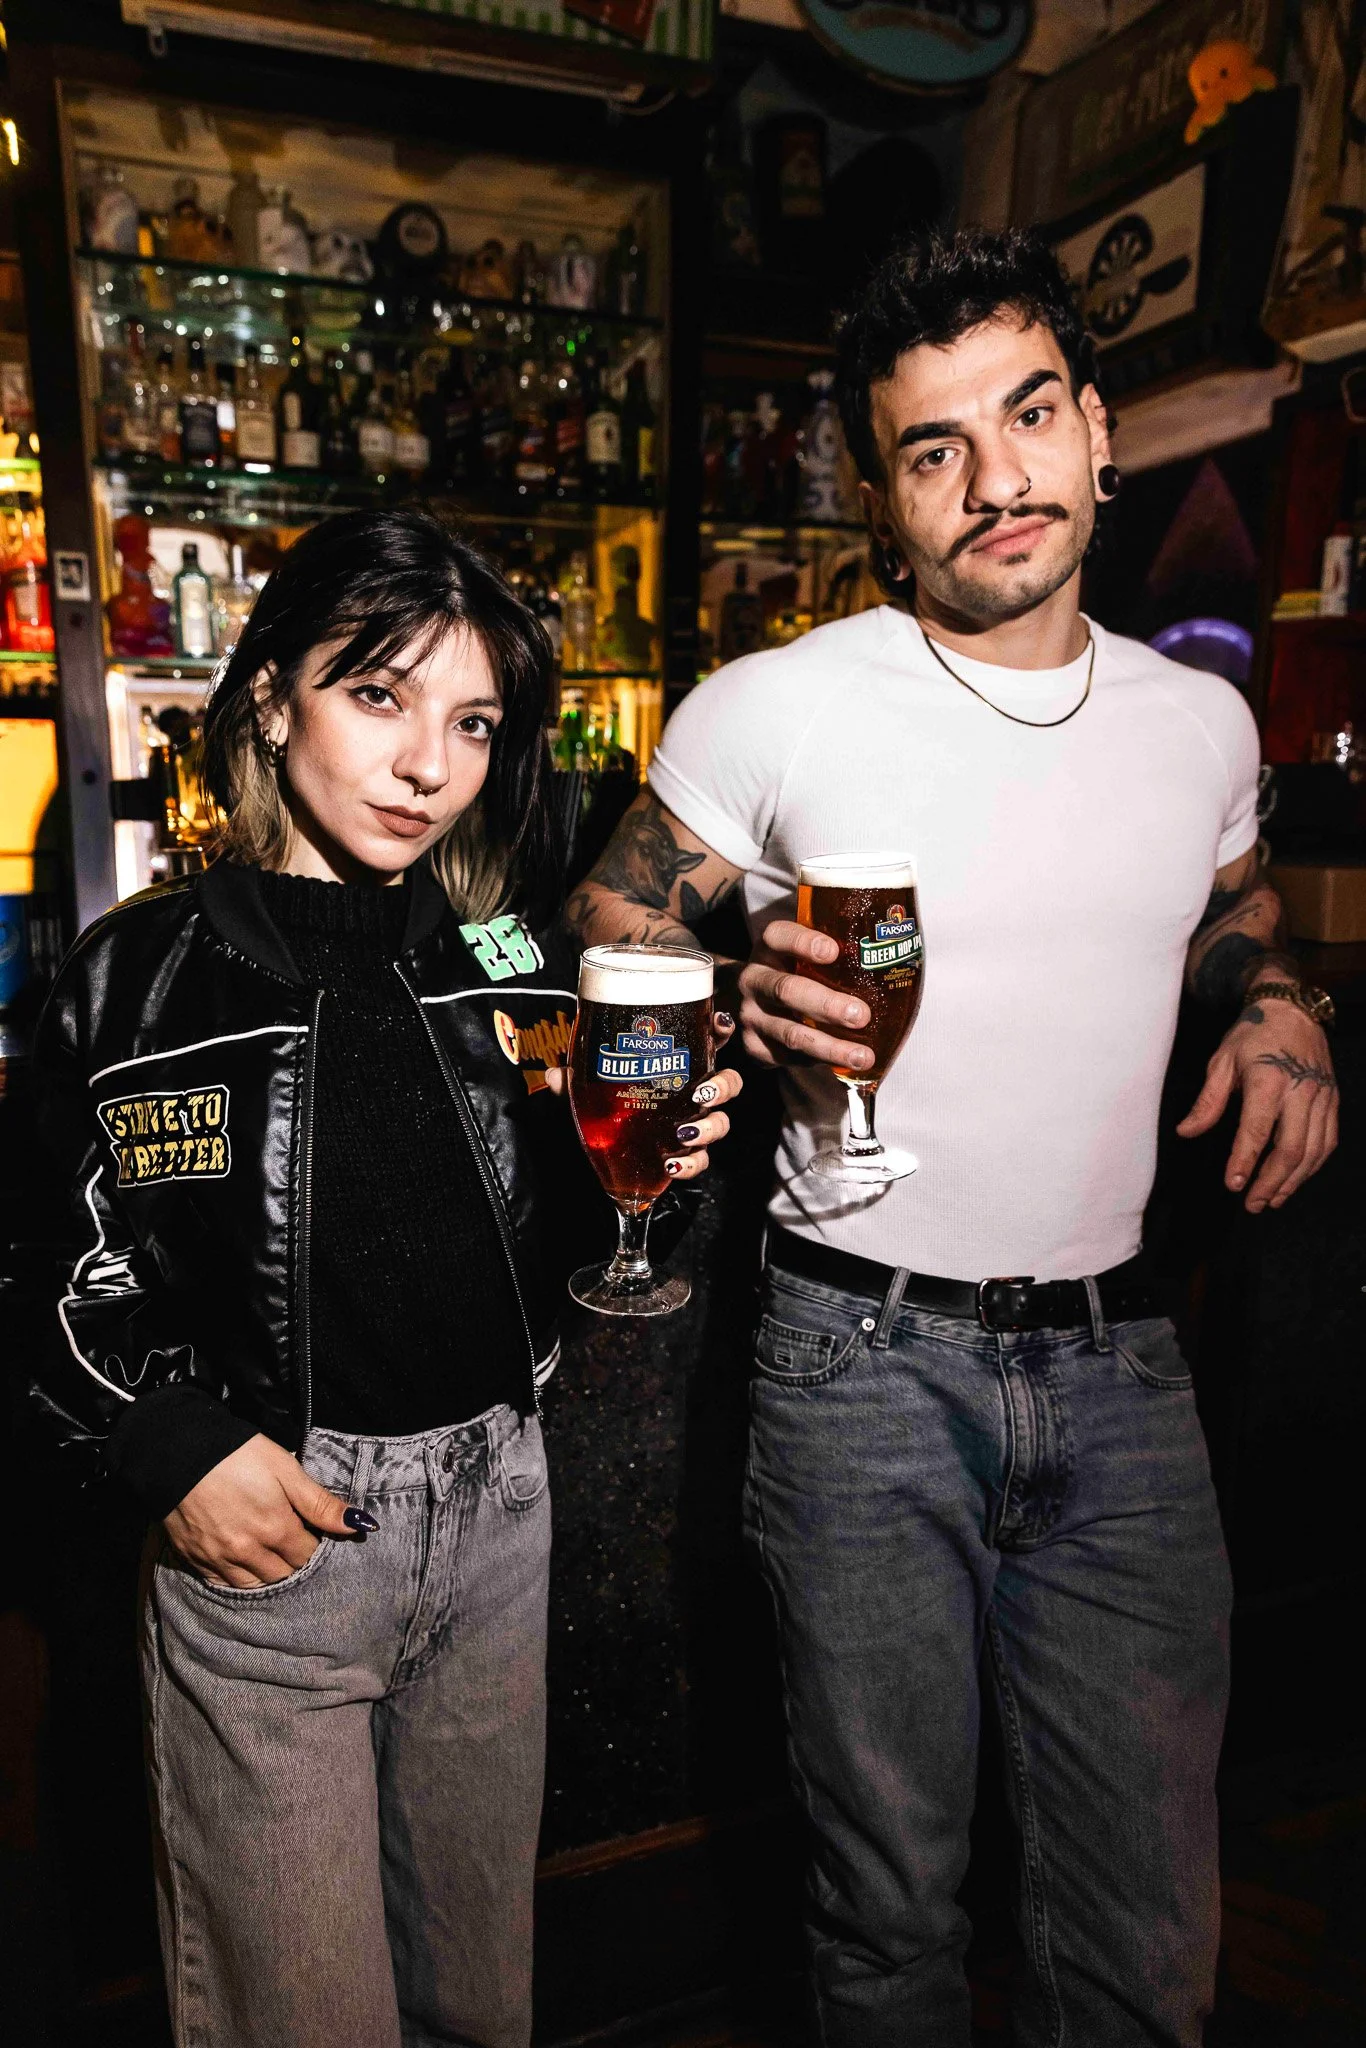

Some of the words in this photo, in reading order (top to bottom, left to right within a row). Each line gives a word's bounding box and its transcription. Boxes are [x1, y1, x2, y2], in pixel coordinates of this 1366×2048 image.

[880, 922, 913, 937] FARSONS
[863, 945, 897, 964] GREEN
[897, 939, 913, 957] HOP
[622, 1037, 669, 1050] FARSONS
[602, 1058, 639, 1076] BLUE
[643, 1054, 687, 1075] LABEL
[188, 1092, 222, 1128] TO
[134, 1136, 226, 1179] BETTER
